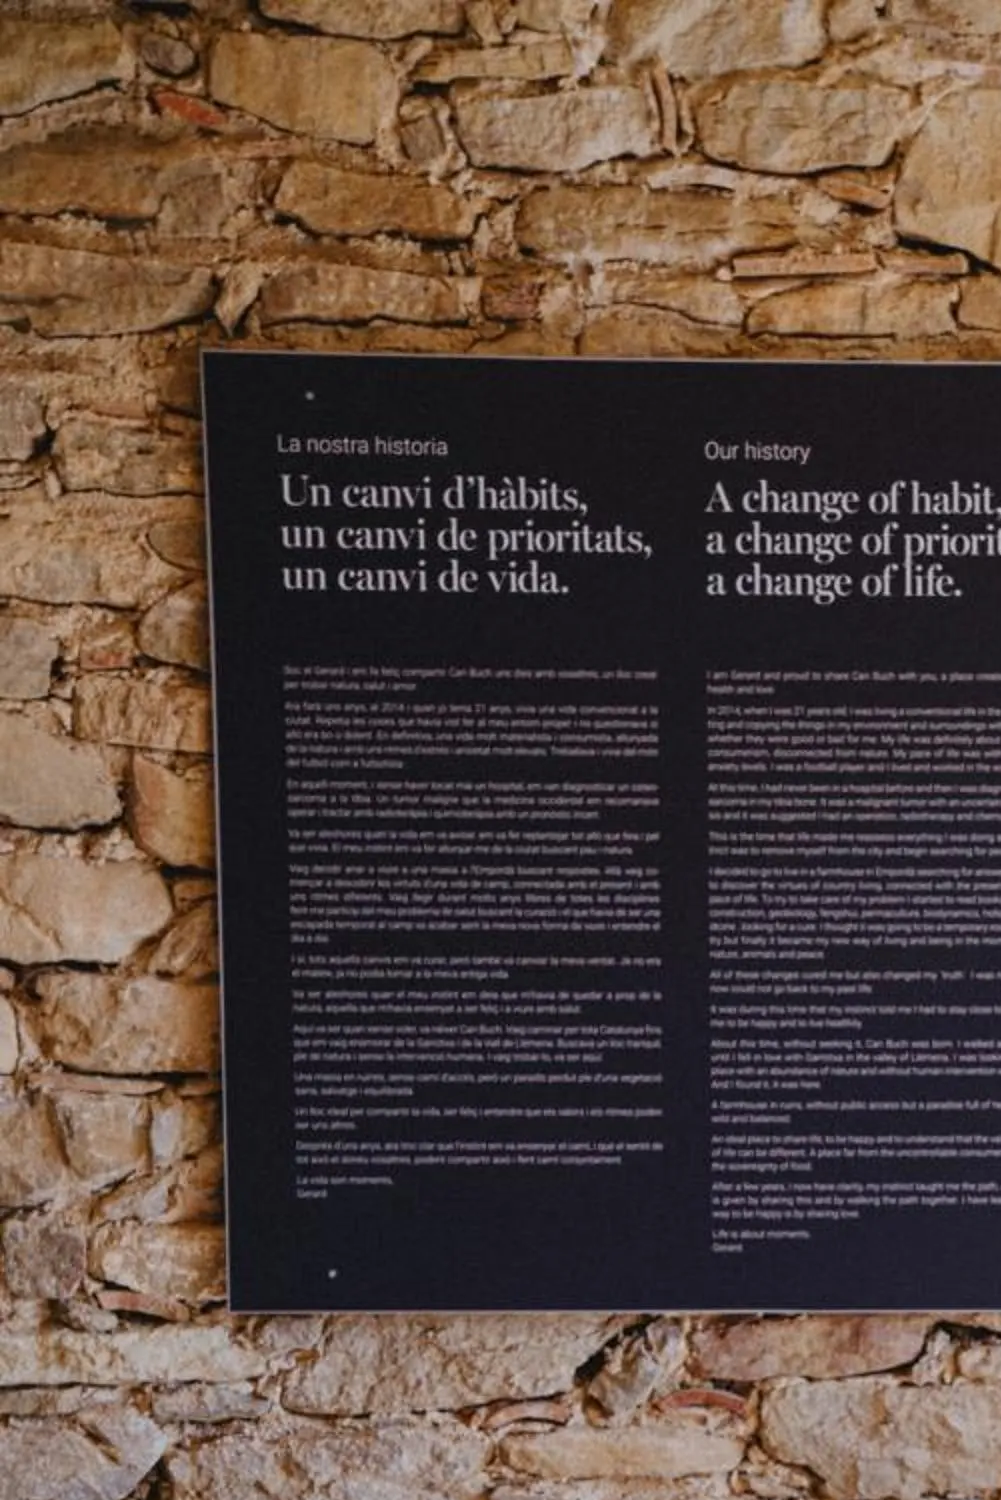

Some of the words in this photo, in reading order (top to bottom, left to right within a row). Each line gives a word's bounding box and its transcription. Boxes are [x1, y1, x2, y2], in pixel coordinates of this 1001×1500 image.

[278, 436, 300, 453] La
[308, 438, 368, 455] nostra
[376, 437, 448, 456] historia
[705, 441, 740, 460] Our
[745, 442, 810, 465] history
[282, 475, 331, 507] Un
[343, 476, 431, 508] canvi
[443, 476, 587, 515] d'hàbits,
[706, 482, 733, 512] A
[742, 480, 859, 522] change
[869, 481, 907, 514] of
[282, 526, 325, 549] un
[337, 518, 425, 549] canvi
[438, 518, 477, 551] de
[488, 521, 652, 561] prioritats,
[706, 532, 726, 555] a
[735, 521, 852, 563] change
[861, 522, 900, 555] of
[284, 568, 326, 590] un
[338, 560, 426, 591] canvi
[438, 559, 478, 592] de
[488, 560, 568, 593] vida.
[707, 574, 726, 596] a
[736, 562, 852, 604] change
[862, 562, 901, 596] of
[904, 563, 962, 598] life.
